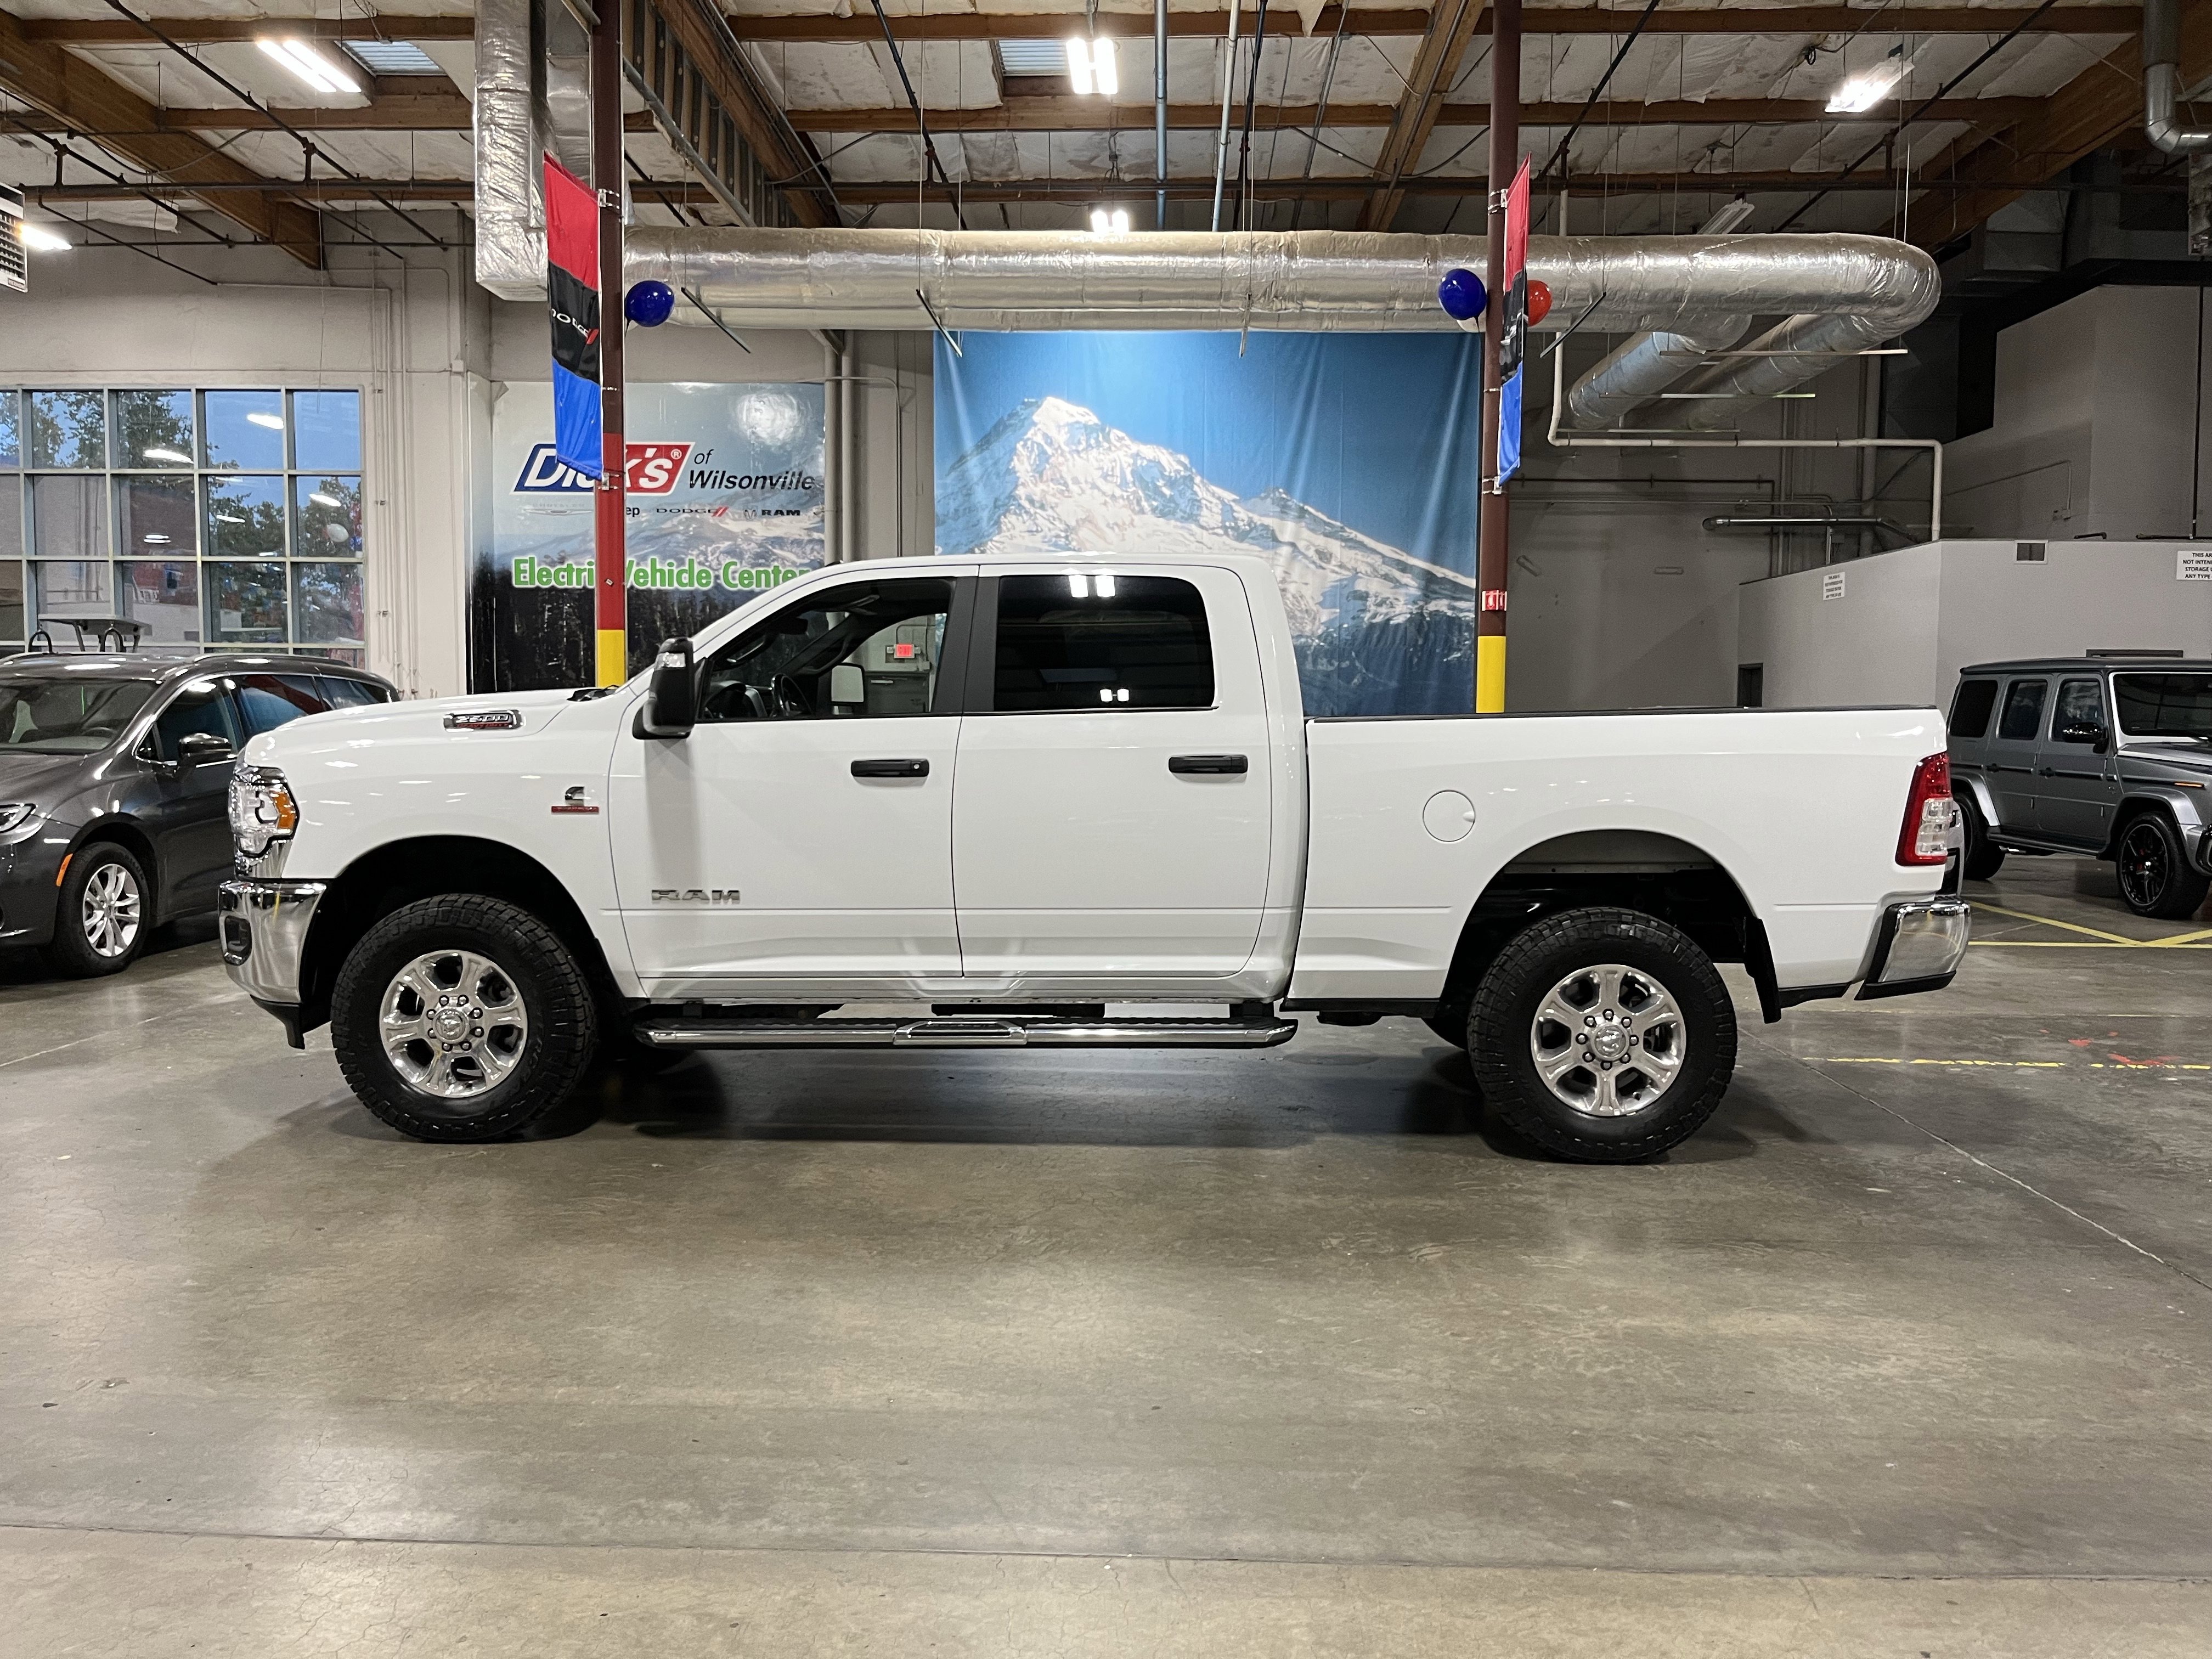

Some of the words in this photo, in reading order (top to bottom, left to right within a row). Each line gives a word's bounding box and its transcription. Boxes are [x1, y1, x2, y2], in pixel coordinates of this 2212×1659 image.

[693, 449, 714, 465] of
[689, 470, 815, 490] Wilsonville
[626, 506, 640, 517] ep
[514, 557, 595, 587] Electri
[651, 889, 740, 901] RAM
